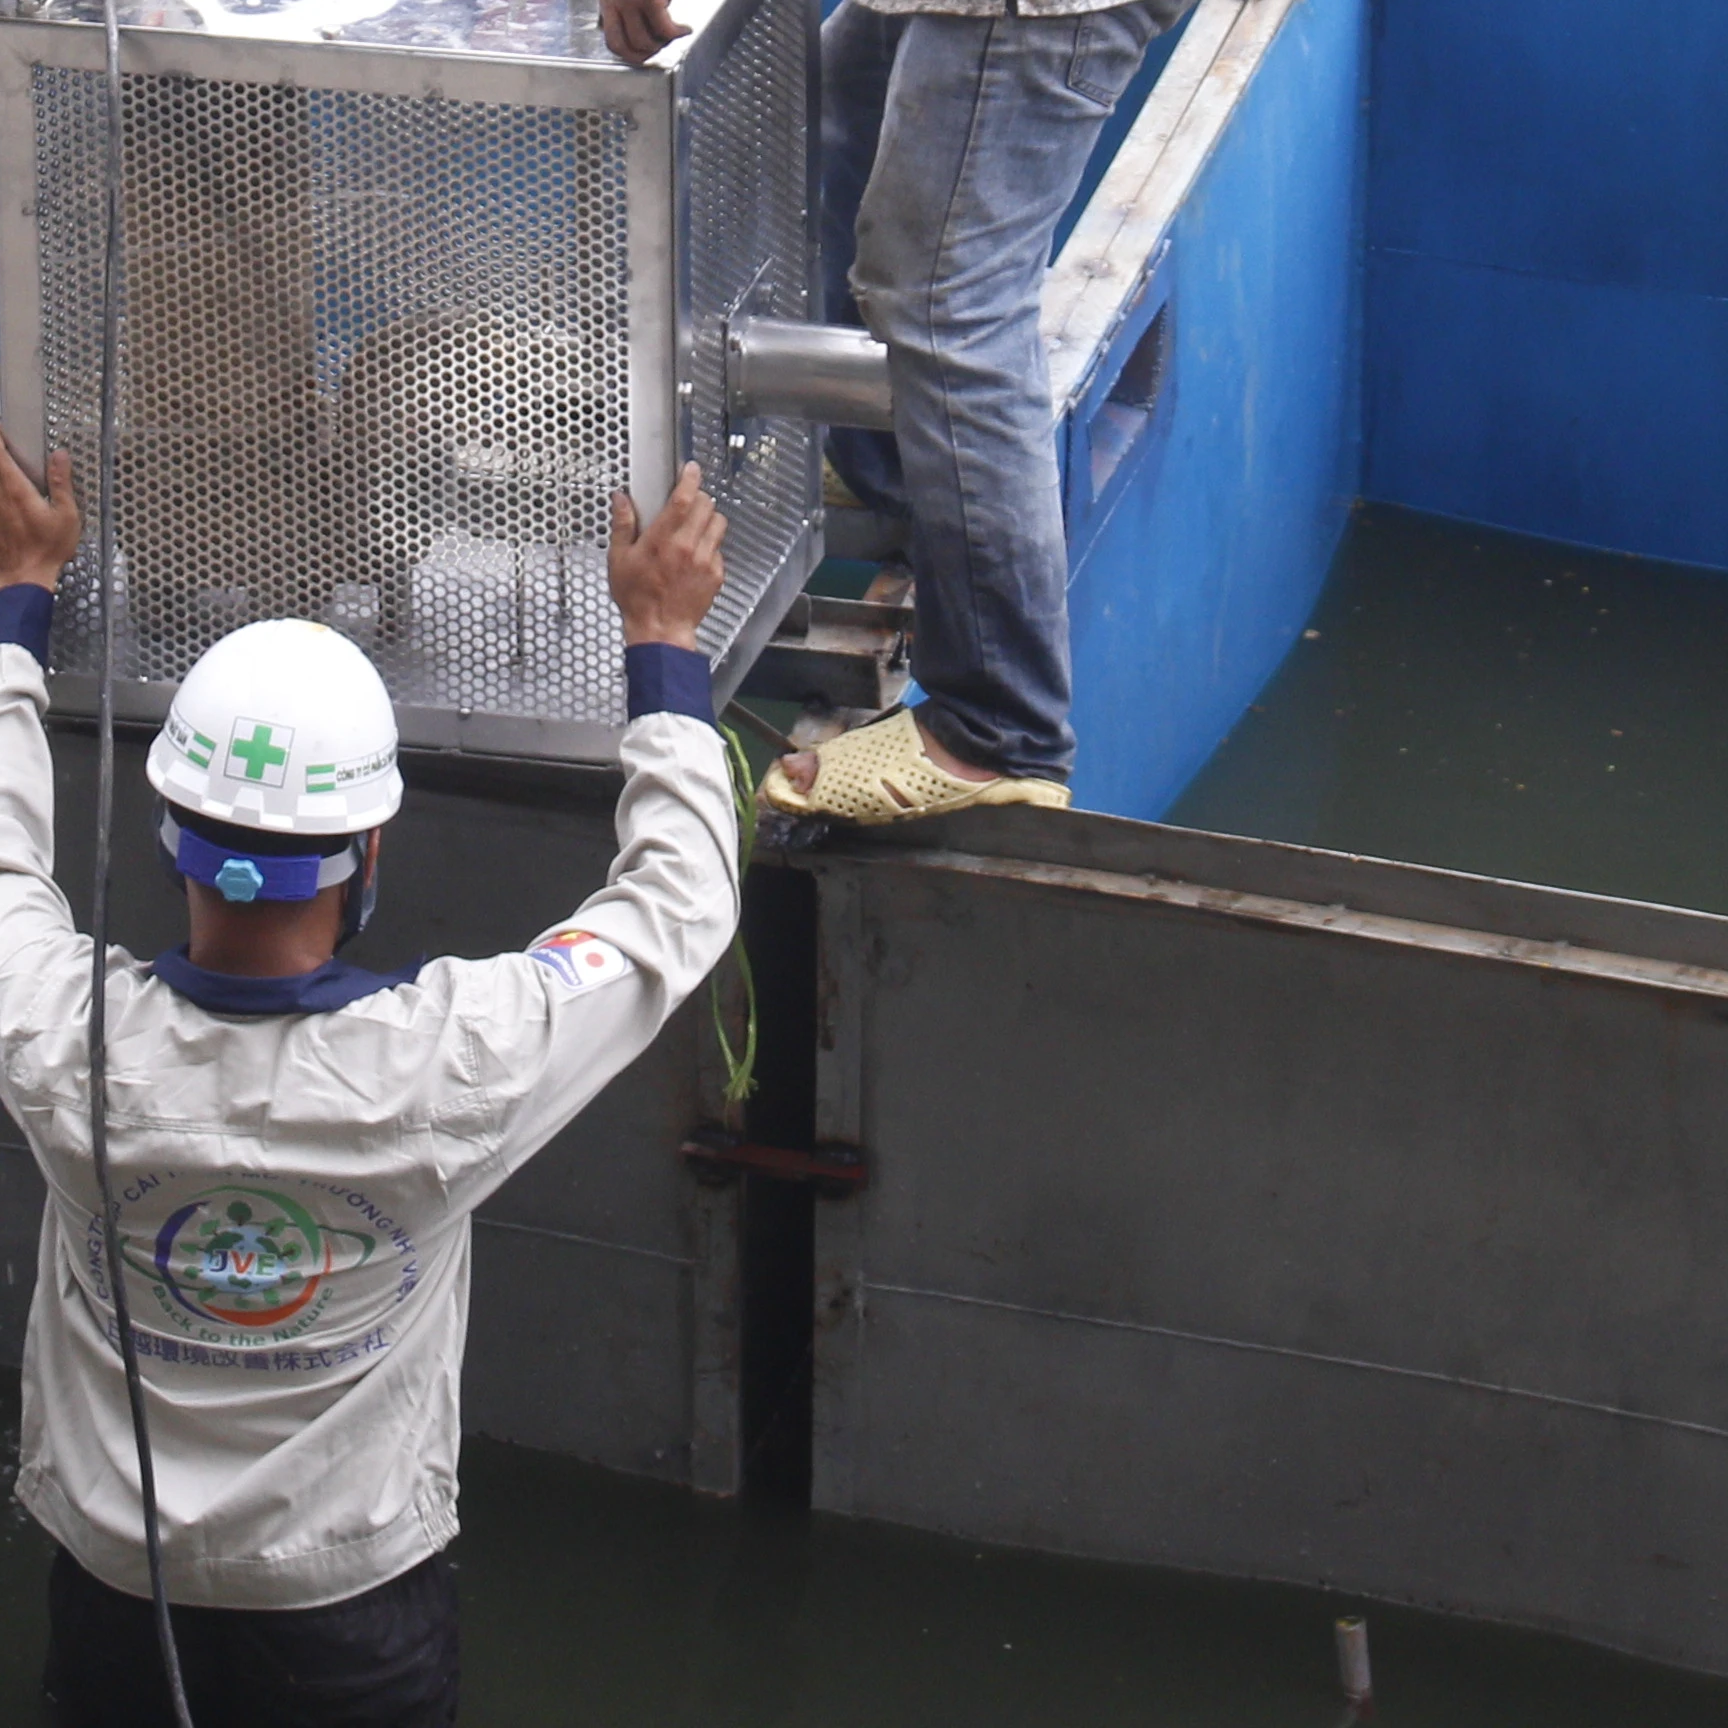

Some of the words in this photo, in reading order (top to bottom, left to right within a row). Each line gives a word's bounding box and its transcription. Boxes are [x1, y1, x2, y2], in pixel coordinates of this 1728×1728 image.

[209, 1249, 277, 1278] JVE
[152, 1284, 193, 1333] Back
[199, 1327, 221, 1344] to
[229, 1332, 266, 1347] the
[273, 1286, 334, 1344] Nature
